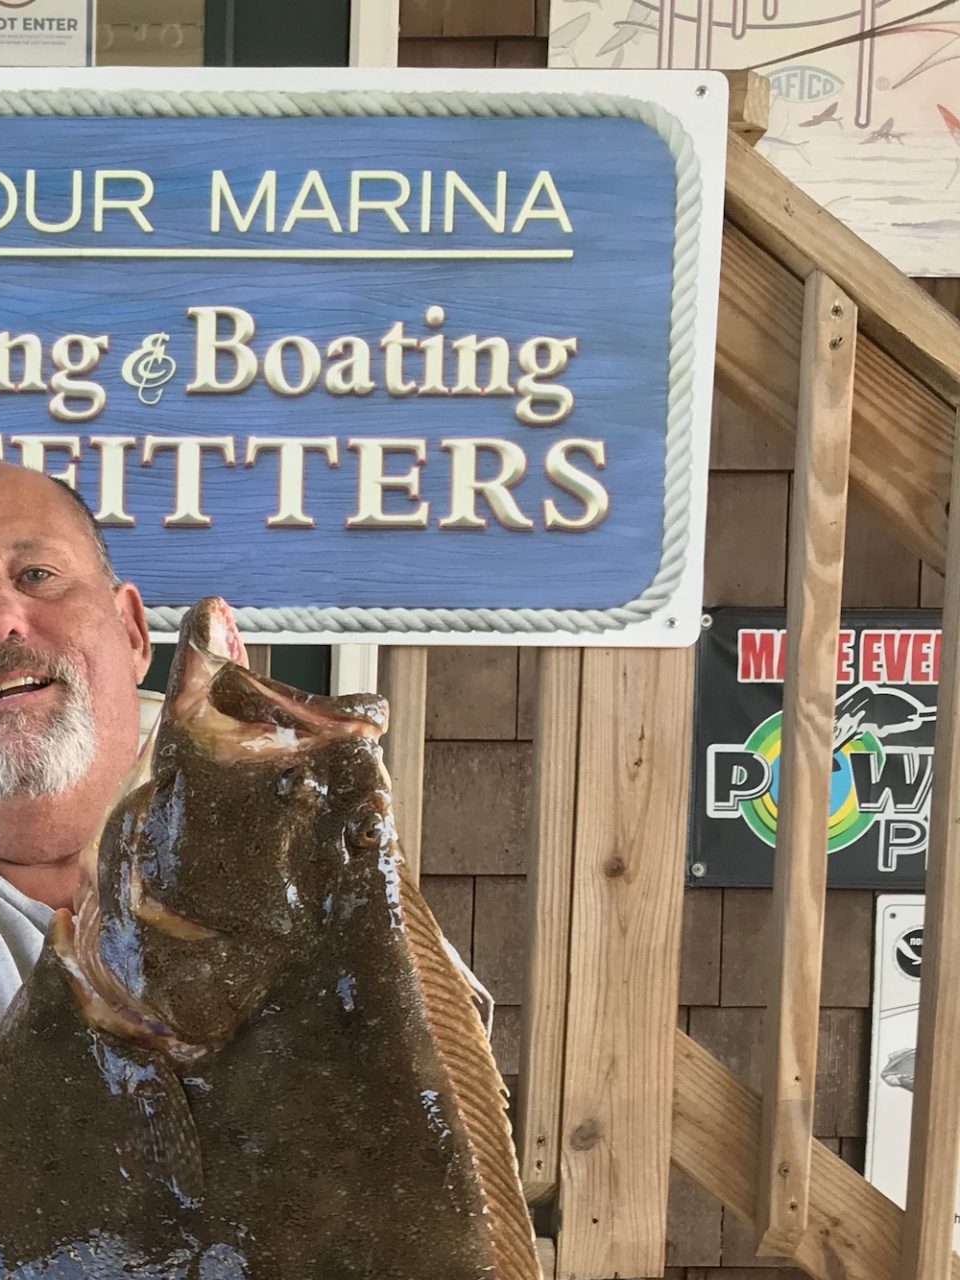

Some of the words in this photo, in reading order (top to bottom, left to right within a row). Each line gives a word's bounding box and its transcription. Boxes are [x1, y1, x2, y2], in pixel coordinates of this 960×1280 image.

[22, 18, 78, 32] ENTER
[209, 170, 574, 234] MARINA
[121, 332, 177, 405] &
[185, 304, 578, 425] Boating
[738, 628, 855, 684] ME
[860, 629, 942, 685] EVE
